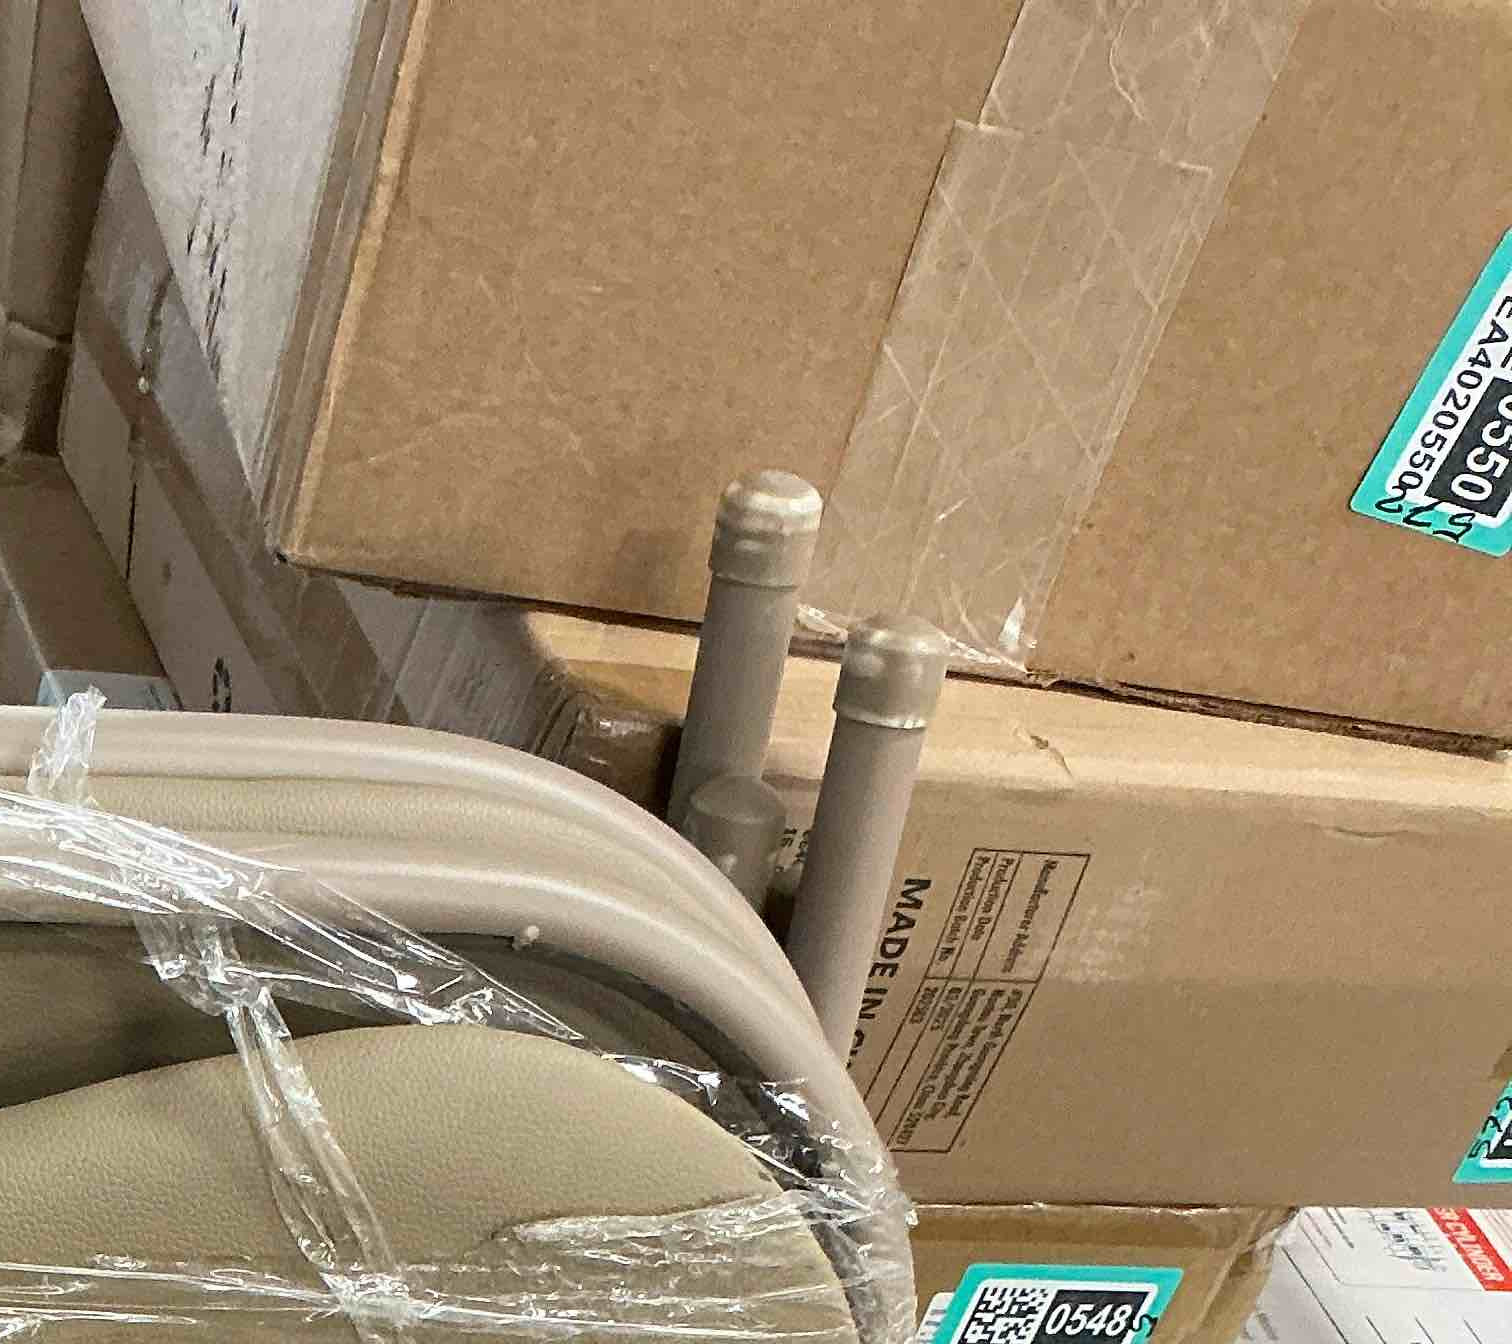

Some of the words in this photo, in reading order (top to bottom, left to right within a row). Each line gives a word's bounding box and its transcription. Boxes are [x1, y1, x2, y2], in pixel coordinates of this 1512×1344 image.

[868, 878, 932, 979] MADE
[858, 987, 889, 1020] IN
[1045, 1303, 1133, 1336] 0548
